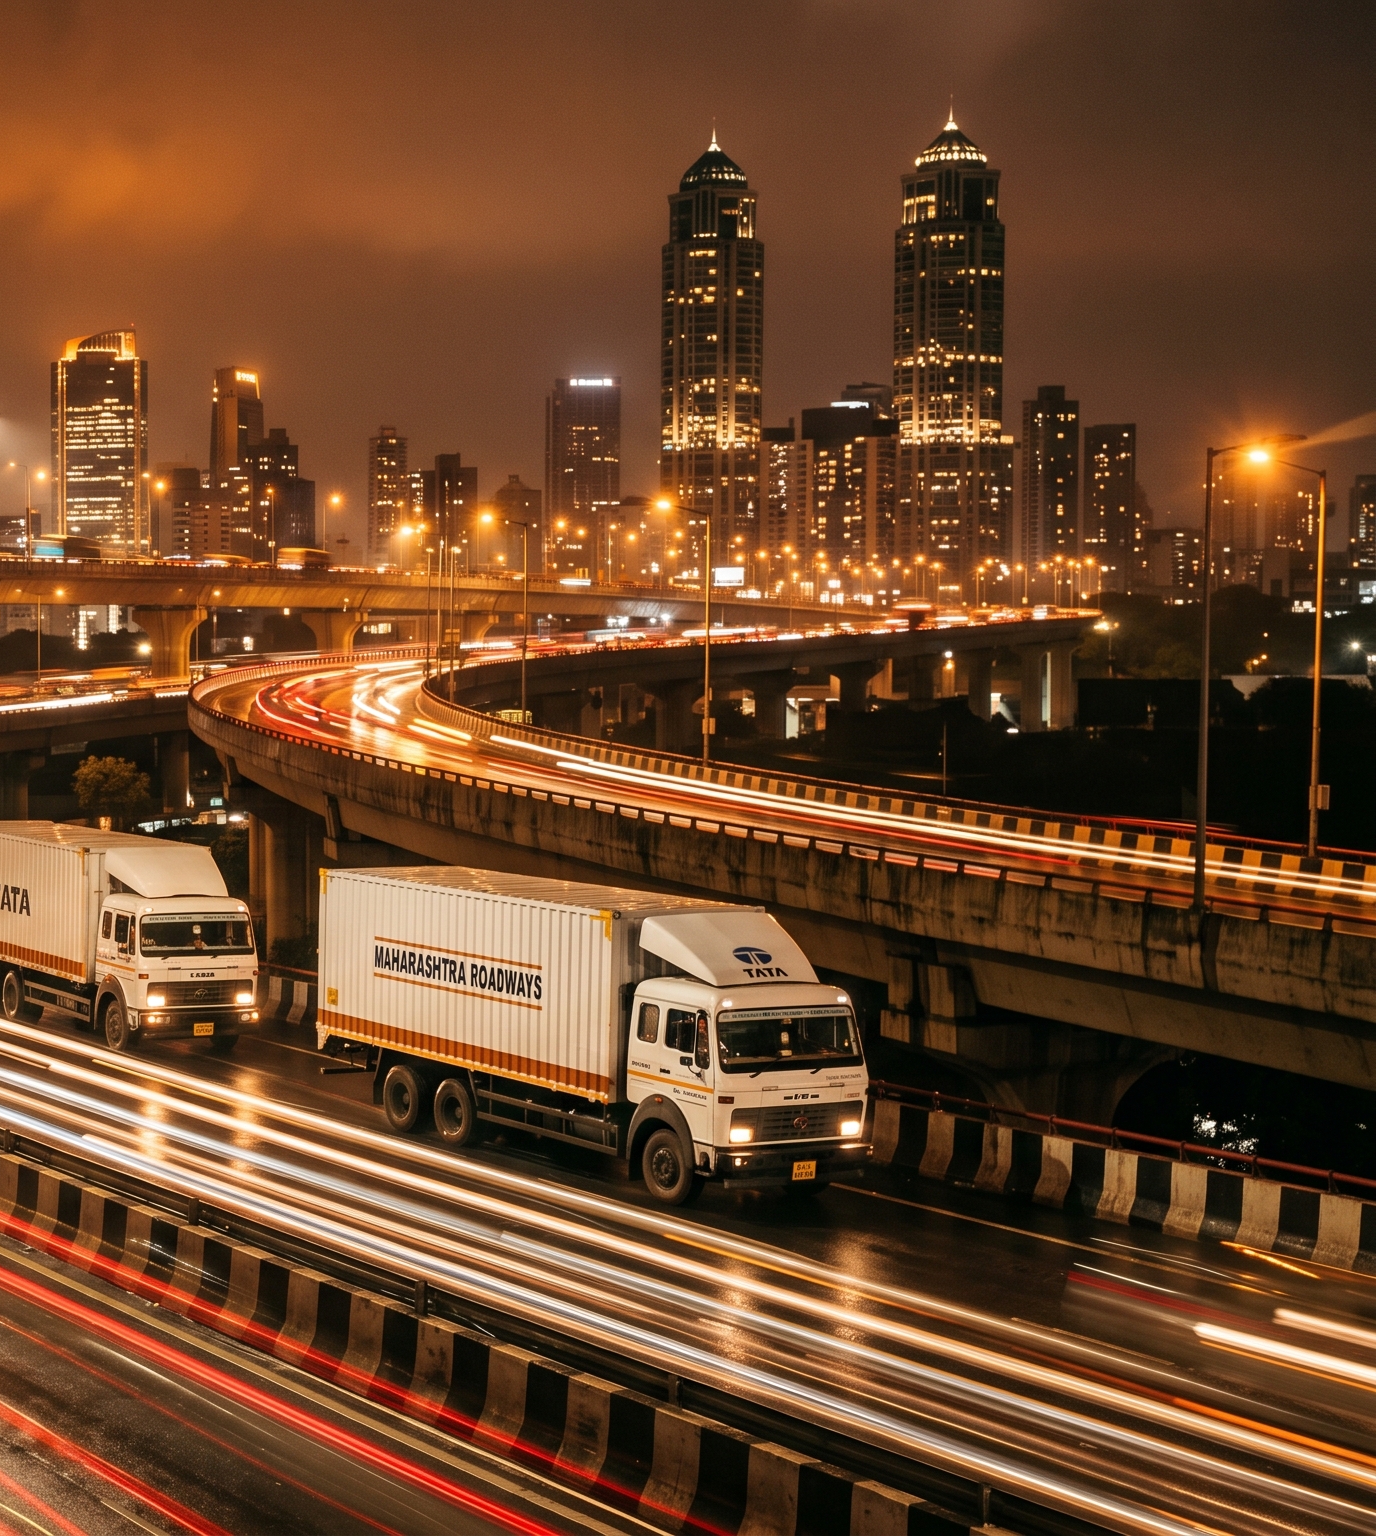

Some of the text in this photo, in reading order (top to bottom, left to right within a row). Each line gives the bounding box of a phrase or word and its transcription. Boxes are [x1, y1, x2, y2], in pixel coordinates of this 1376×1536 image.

[374, 945, 542, 1000] MAHARASHTRA ROADWAYS
[742, 967, 789, 978] TATA
